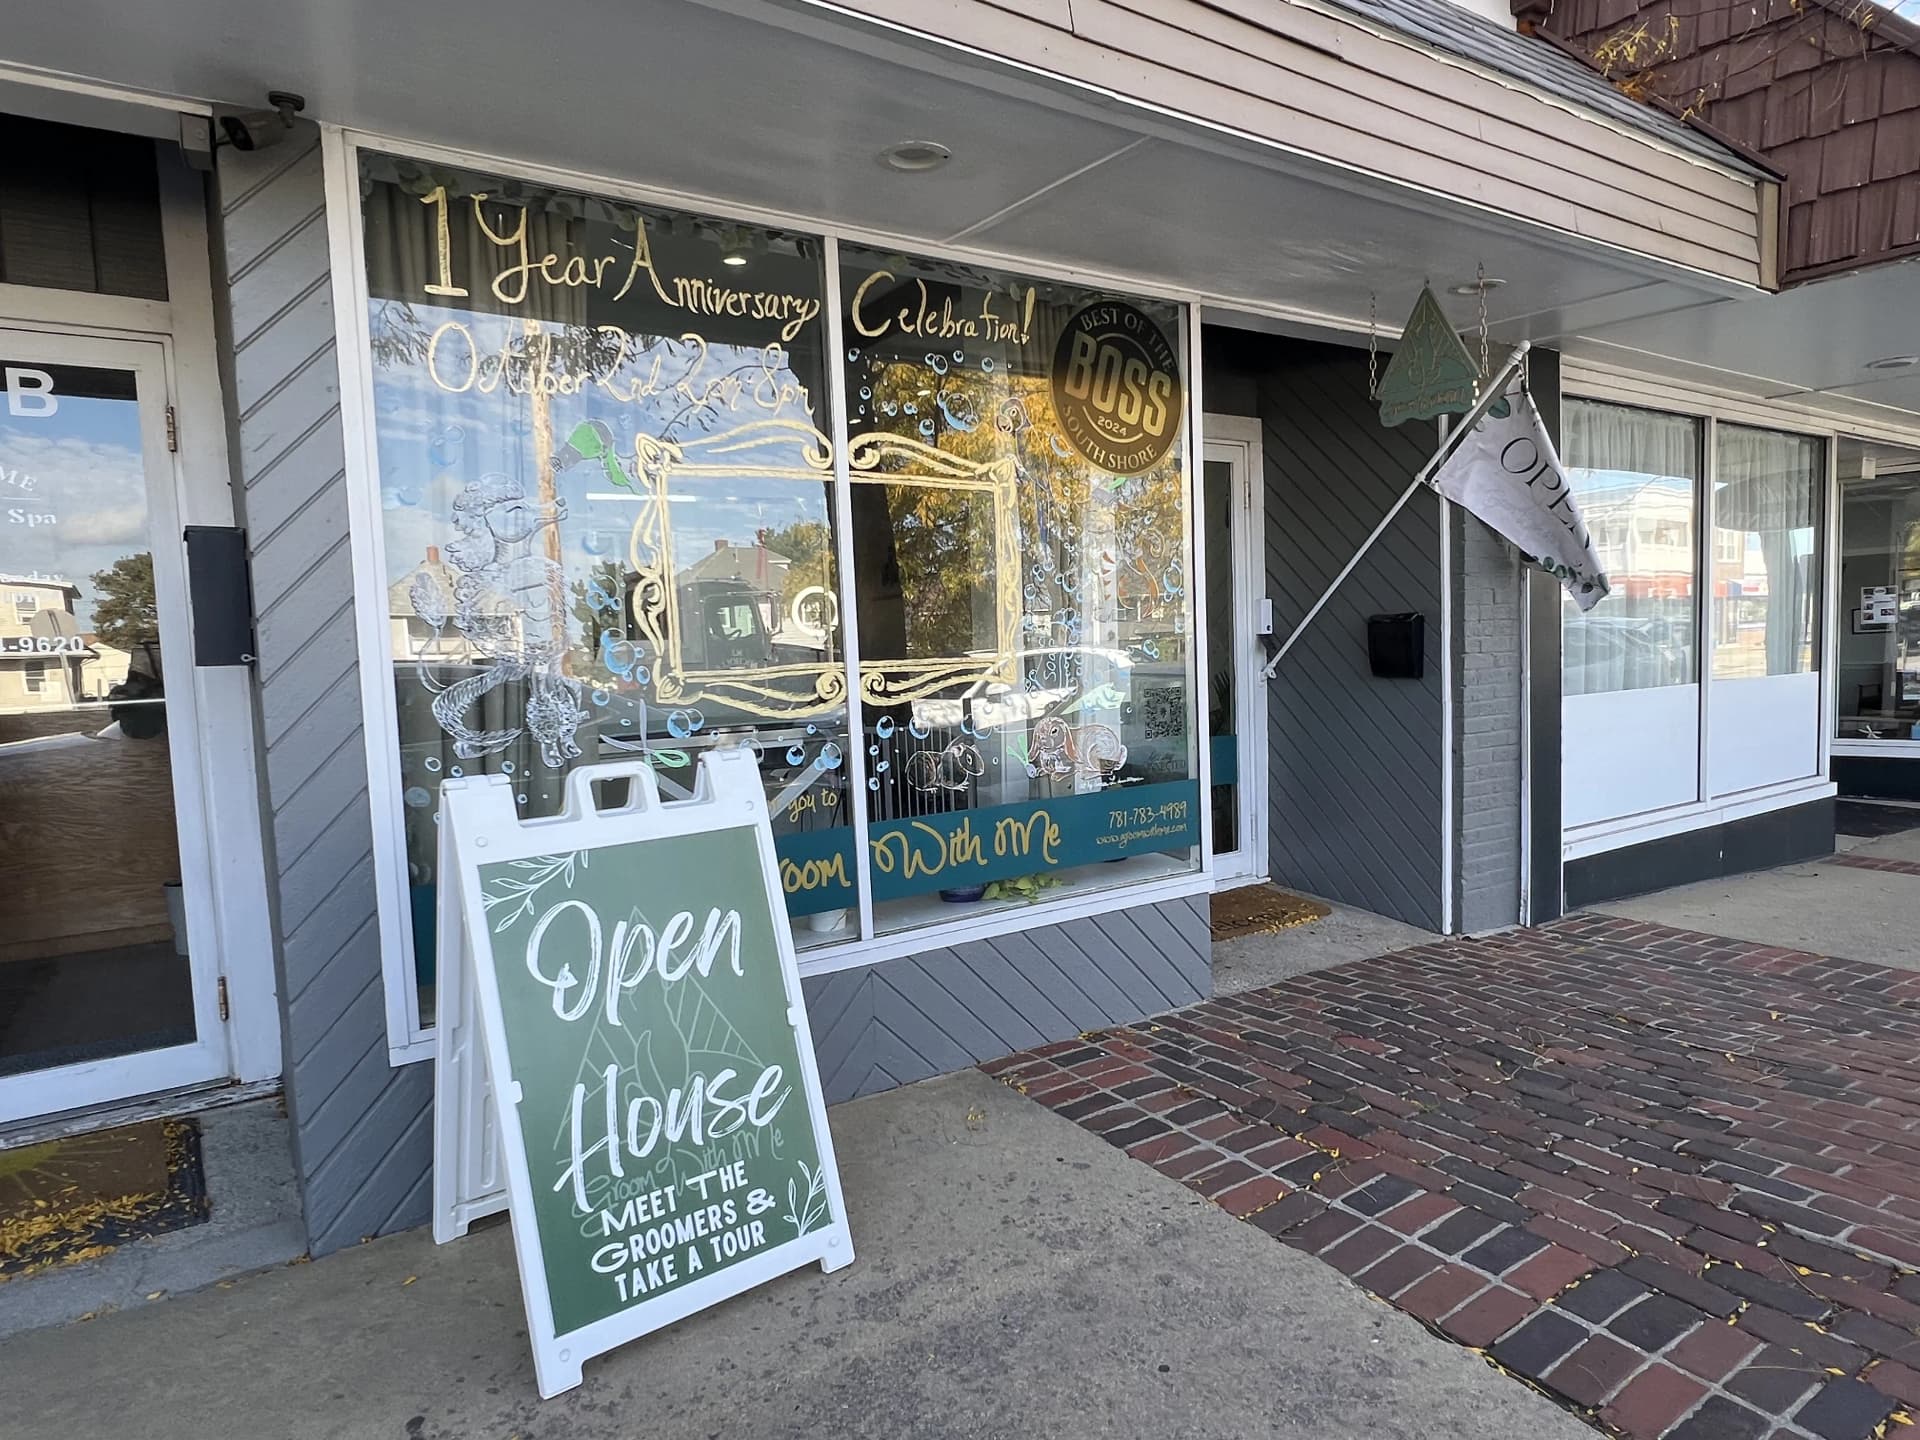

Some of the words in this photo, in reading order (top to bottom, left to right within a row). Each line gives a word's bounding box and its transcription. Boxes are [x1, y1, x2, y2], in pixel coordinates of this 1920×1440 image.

[420, 186, 469, 297] 1
[470, 192, 615, 304] Year
[613, 216, 820, 342] Anniversary
[851, 270, 1035, 345] Celebration!
[428, 318, 592, 393] October
[1080, 308, 1118, 331] BEST
[1124, 313, 1146, 335] OF
[1149, 334, 1173, 372] THE
[5, 366, 58, 418] B
[1064, 330, 1173, 438] BOSS
[1063, 405, 1107, 464] SOUTH
[1107, 444, 1157, 470] SHORE
[1097, 415, 1128, 437] 2024
[7, 508, 57, 528] Spa
[1500, 437, 1591, 550] OPE
[0, 636, 85, 653] -9620
[788, 793, 817, 822] you
[821, 787, 838, 807] to
[1109, 801, 1188, 829] 781-783-4989
[871, 816, 988, 880] With
[994, 810, 1061, 865] Me
[526, 900, 744, 1026] Open
[554, 1064, 792, 1214] House
[590, 1199, 738, 1274] GROOMERS
[746, 1187, 777, 1216] &
[600, 1184, 678, 1237] MEET
[686, 1160, 749, 1200] THE
[614, 1252, 678, 1303] TAKE
[688, 1246, 704, 1274] A
[709, 1220, 767, 1263] TOUR
